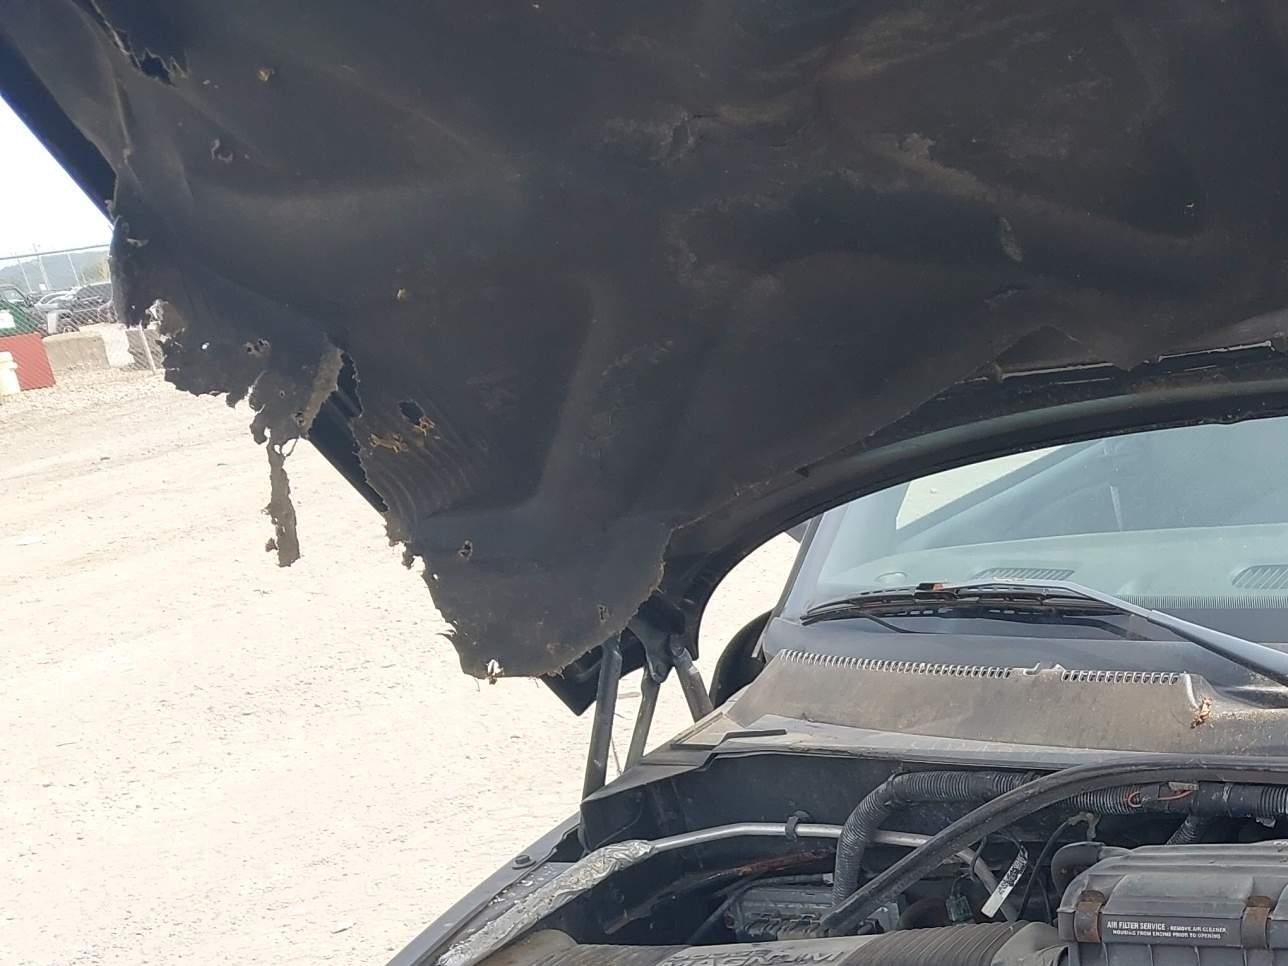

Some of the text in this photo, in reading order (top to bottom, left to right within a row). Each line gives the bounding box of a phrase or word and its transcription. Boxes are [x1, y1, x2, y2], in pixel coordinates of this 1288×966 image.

[1107, 921, 1117, 929] AIR
[1119, 921, 1138, 930] FILTER
[1140, 922, 1165, 931] SERVICE
